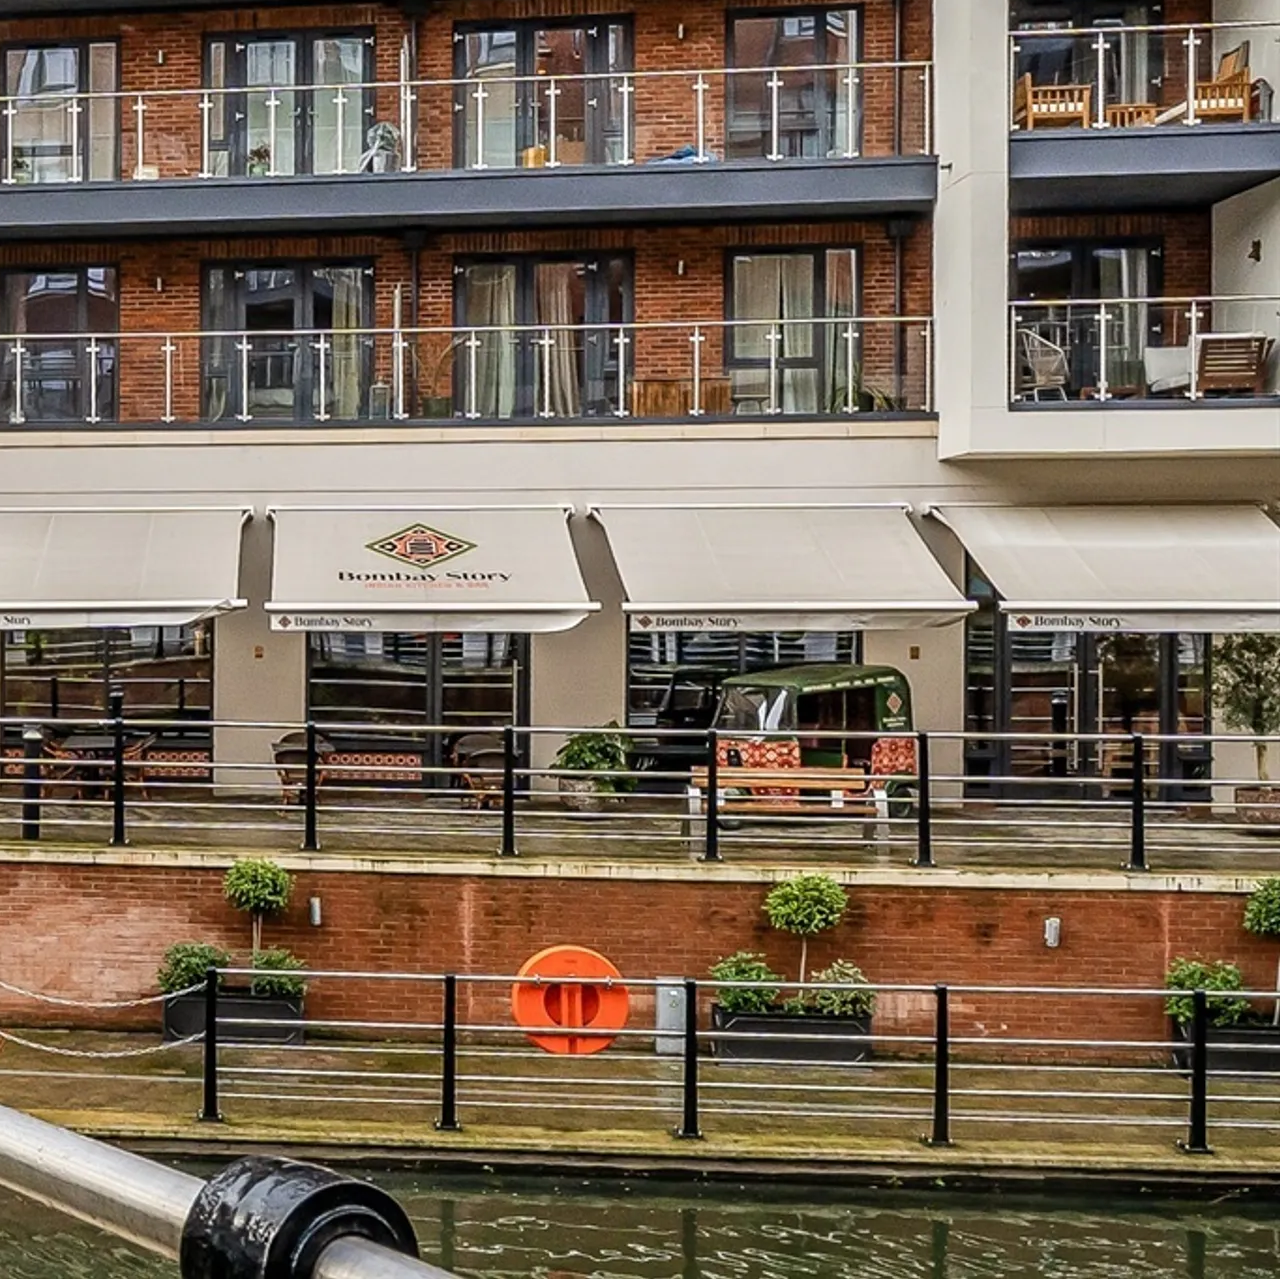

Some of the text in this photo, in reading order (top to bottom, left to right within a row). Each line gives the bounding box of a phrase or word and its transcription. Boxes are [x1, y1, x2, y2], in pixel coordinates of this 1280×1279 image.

[338, 571, 513, 582] Bombay Story
[294, 616, 340, 627] Bombay
[656, 616, 704, 628] Bombay
[1034, 616, 1085, 628] Bombay
